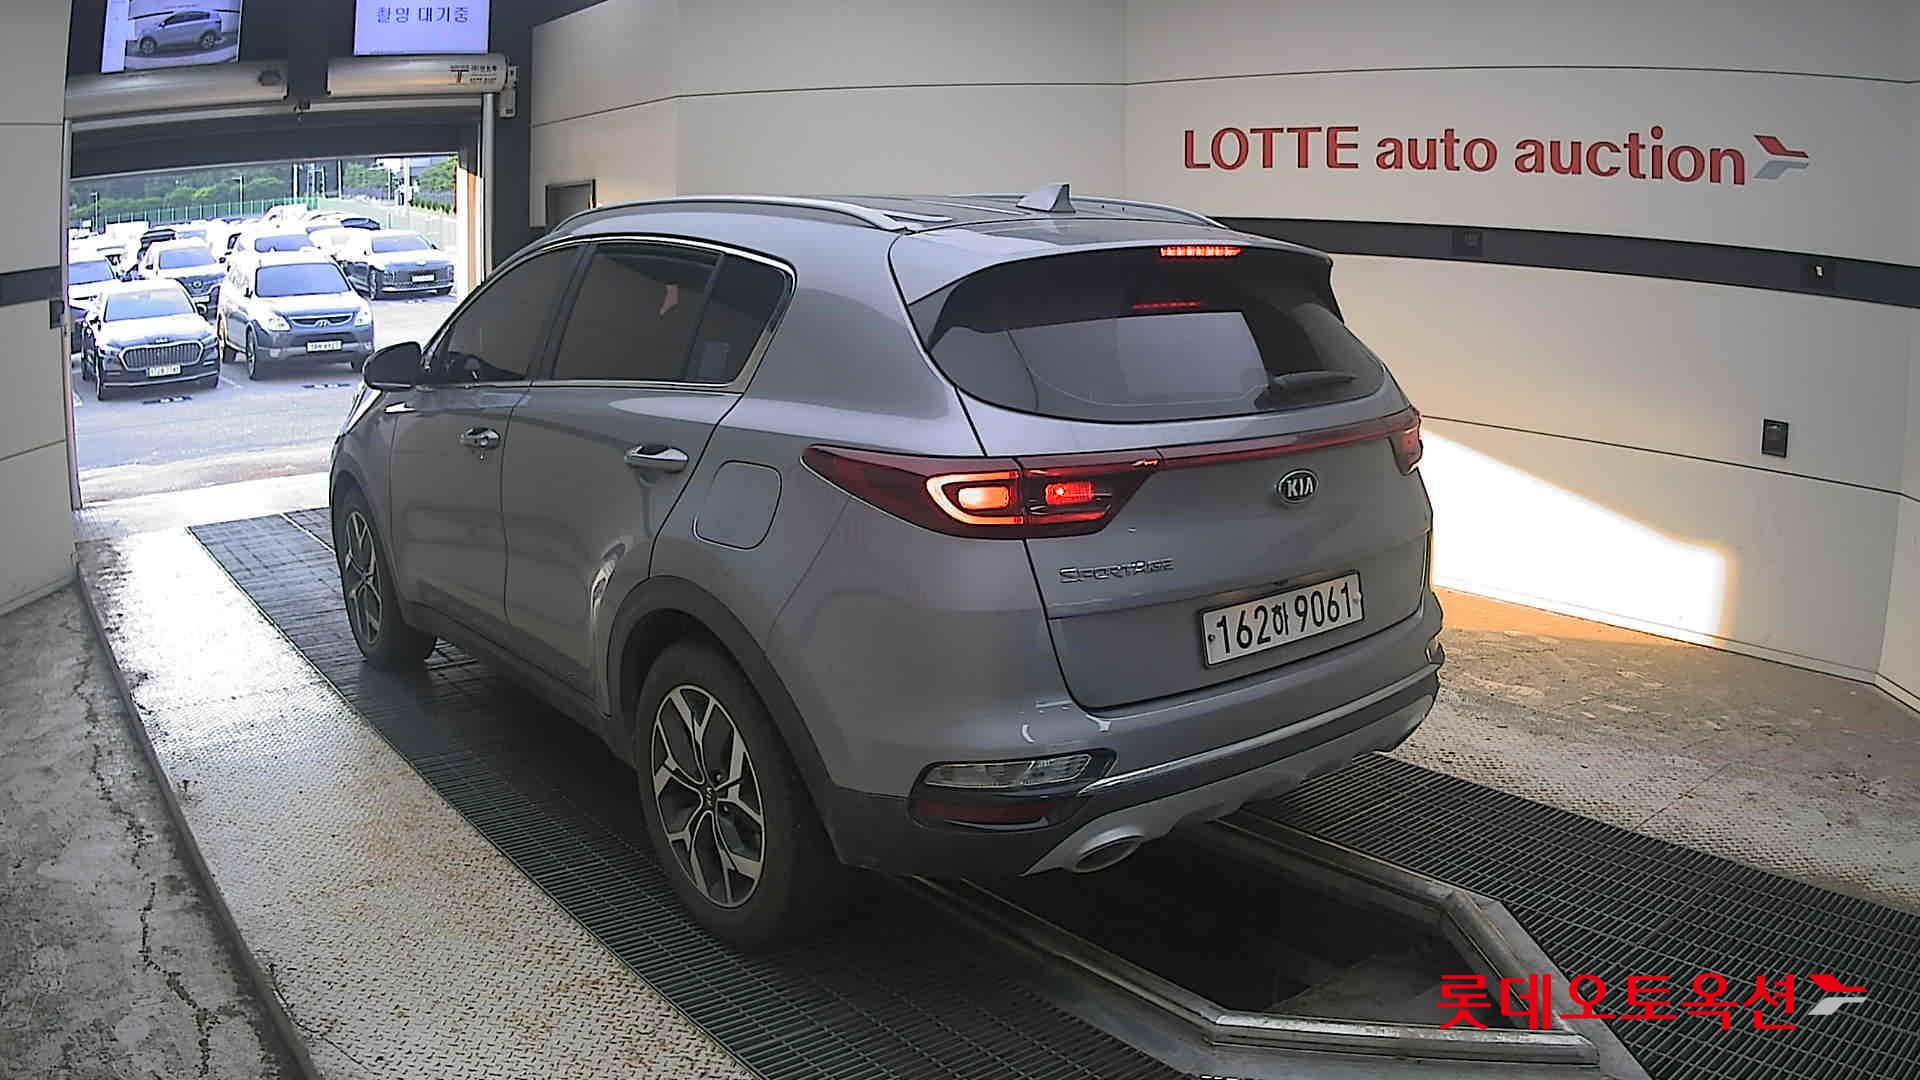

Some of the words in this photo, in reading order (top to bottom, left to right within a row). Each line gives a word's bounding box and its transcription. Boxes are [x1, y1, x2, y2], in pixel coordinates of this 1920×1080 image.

[418, 6, 469, 24] 대기중
[1184, 126, 1359, 170] LOTTE
[1375, 127, 1498, 172] auto
[1514, 125, 1746, 185] auction
[1286, 477, 1314, 498] KIA
